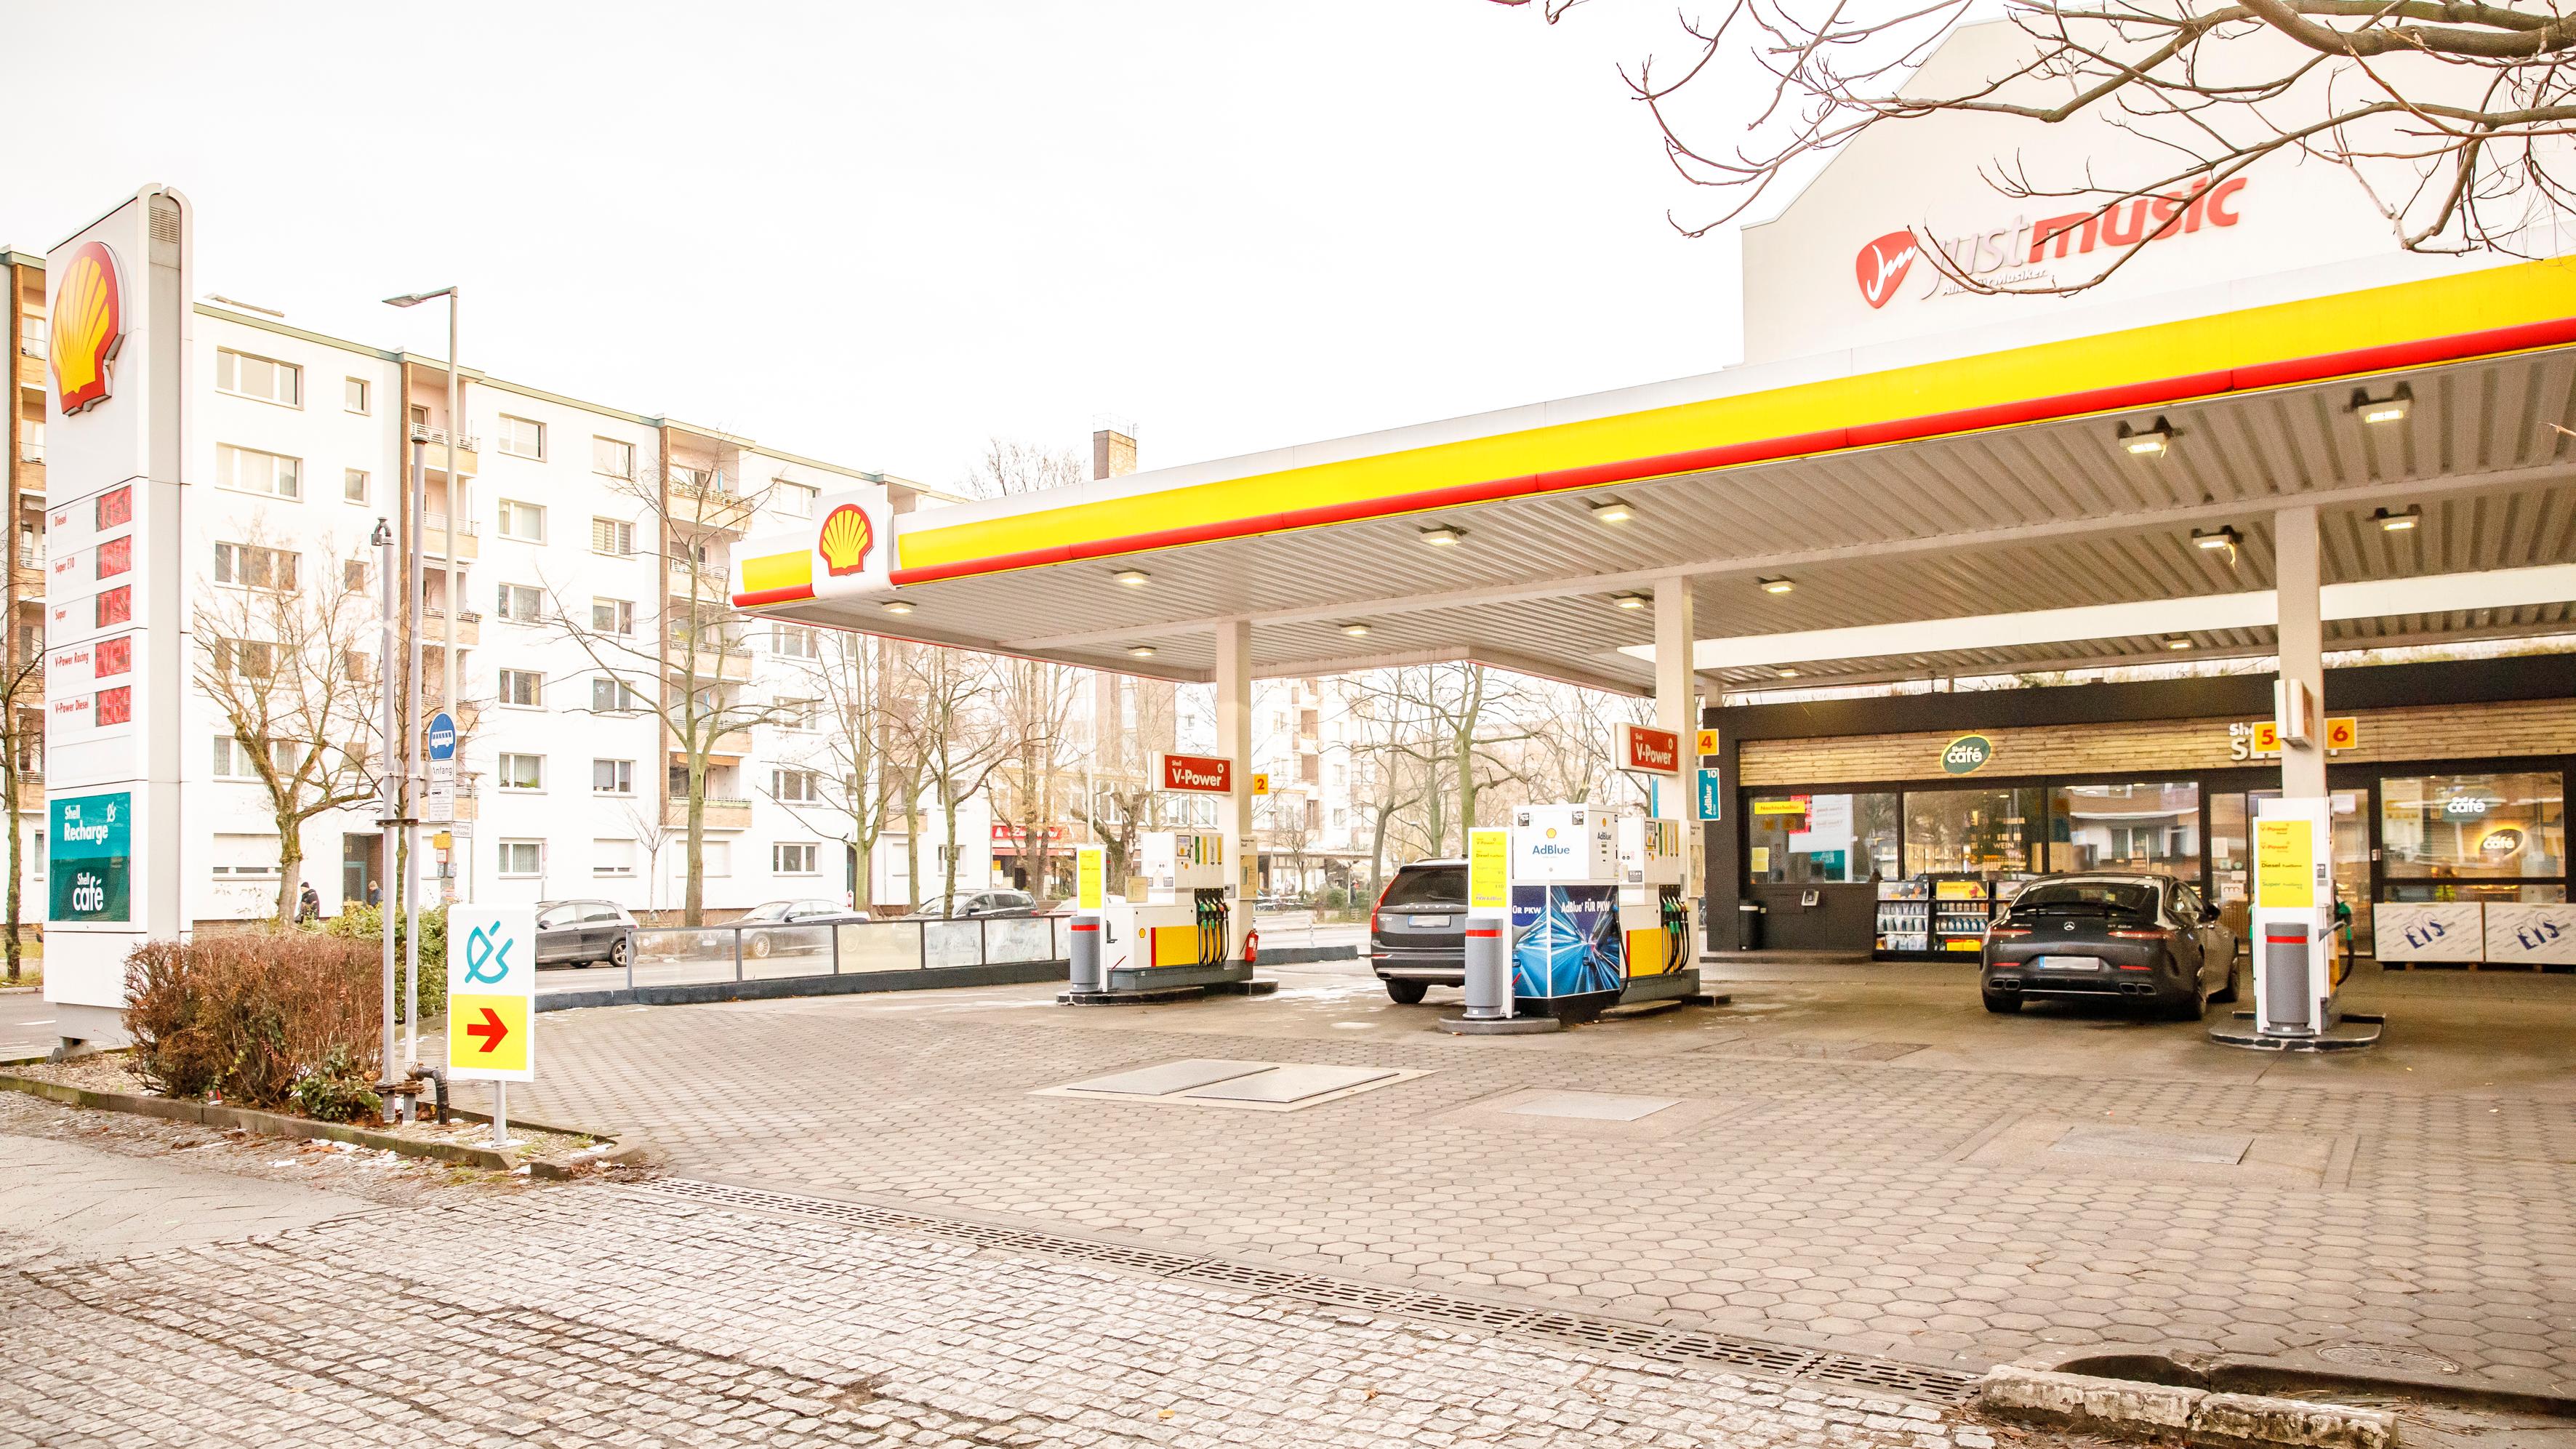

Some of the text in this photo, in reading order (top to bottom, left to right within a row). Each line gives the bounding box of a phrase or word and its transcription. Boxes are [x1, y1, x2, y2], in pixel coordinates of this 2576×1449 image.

[55, 512, 67, 527] Diesel
[55, 562, 66, 575] Super
[55, 609, 66, 621] Super
[55, 656, 73, 668] V-Power
[74, 651, 89, 665] Racing
[55, 702, 73, 714] V-Power
[76, 696, 89, 711] Diesel
[1701, 736, 1712, 748] 4
[2261, 729, 2274, 745] 5
[2333, 726, 2348, 742] 6
[1636, 742, 1672, 766] V-Power
[1947, 746, 1982, 763] café
[1172, 768, 1222, 787] V-Power
[1257, 778, 1264, 790] 2
[65, 804, 81, 820] Shell
[2447, 798, 2486, 813] café
[64, 820, 108, 845] Recharge
[1532, 844, 1570, 854] AdBlue
[77, 872, 90, 886] Shell
[73, 875, 103, 911] café
[1512, 905, 1522, 914] ÜR
[1585, 898, 1595, 912] FÜR
[1597, 901, 1610, 912] PKW
[2402, 912, 2445, 950] EIS
[2510, 912, 2560, 951] EIS
